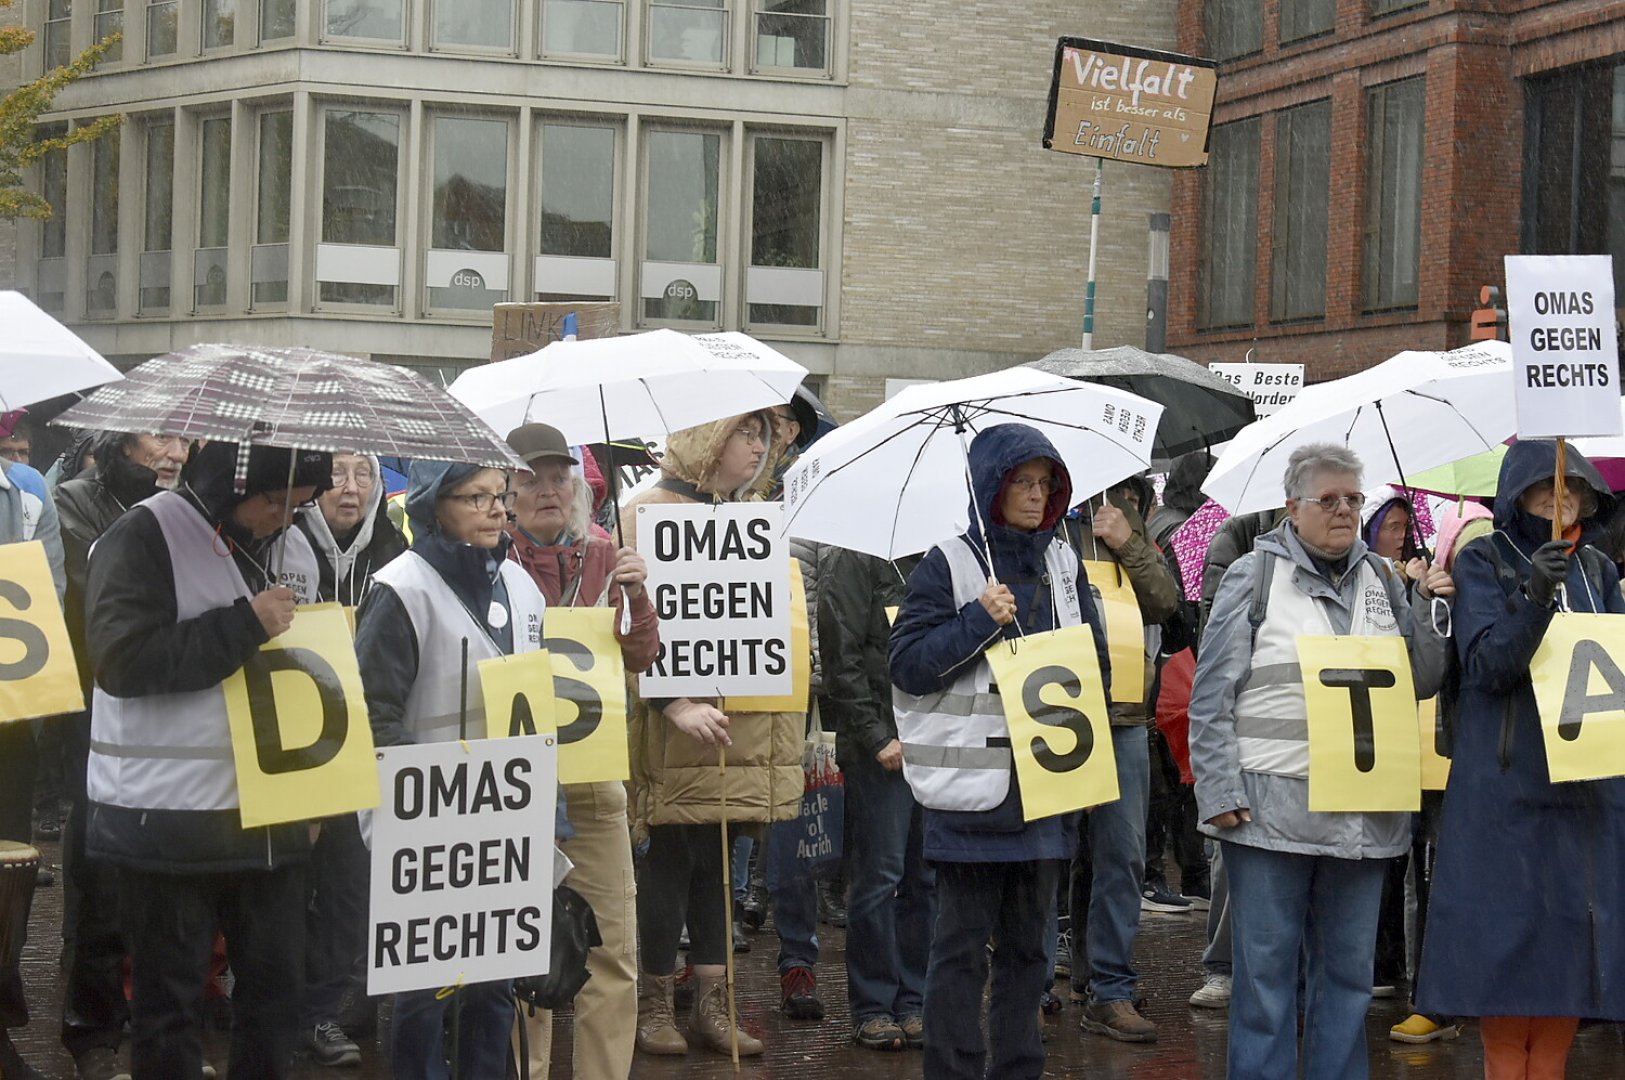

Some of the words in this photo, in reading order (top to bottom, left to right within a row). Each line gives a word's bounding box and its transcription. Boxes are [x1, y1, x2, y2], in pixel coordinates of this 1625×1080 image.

[1072, 51, 1195, 106] Vielfalt
[1090, 96, 1111, 111] ist
[1116, 99, 1159, 118] besser
[1163, 107, 1186, 121] als
[1073, 119, 1161, 158] Einfalt
[454, 272, 480, 289] dsp
[667, 284, 693, 299] dsp
[1534, 291, 1594, 315] OMAS
[1530, 327, 1601, 351] GEGEN
[1254, 371, 1300, 386] Beste
[1526, 363, 1609, 388] RECHTS
[654, 518, 771, 562] OMAS
[655, 581, 773, 621] GEGEN
[1365, 606, 1392, 616] RECHT
[646, 638, 787, 677] RECHTS
[1558, 639, 1625, 742] A
[244, 647, 349, 775] D
[1022, 665, 1094, 773] S
[1319, 668, 1396, 773] T
[393, 757, 532, 821] OMAS
[391, 836, 531, 895] GEGEN
[374, 906, 541, 969] RECHTS
